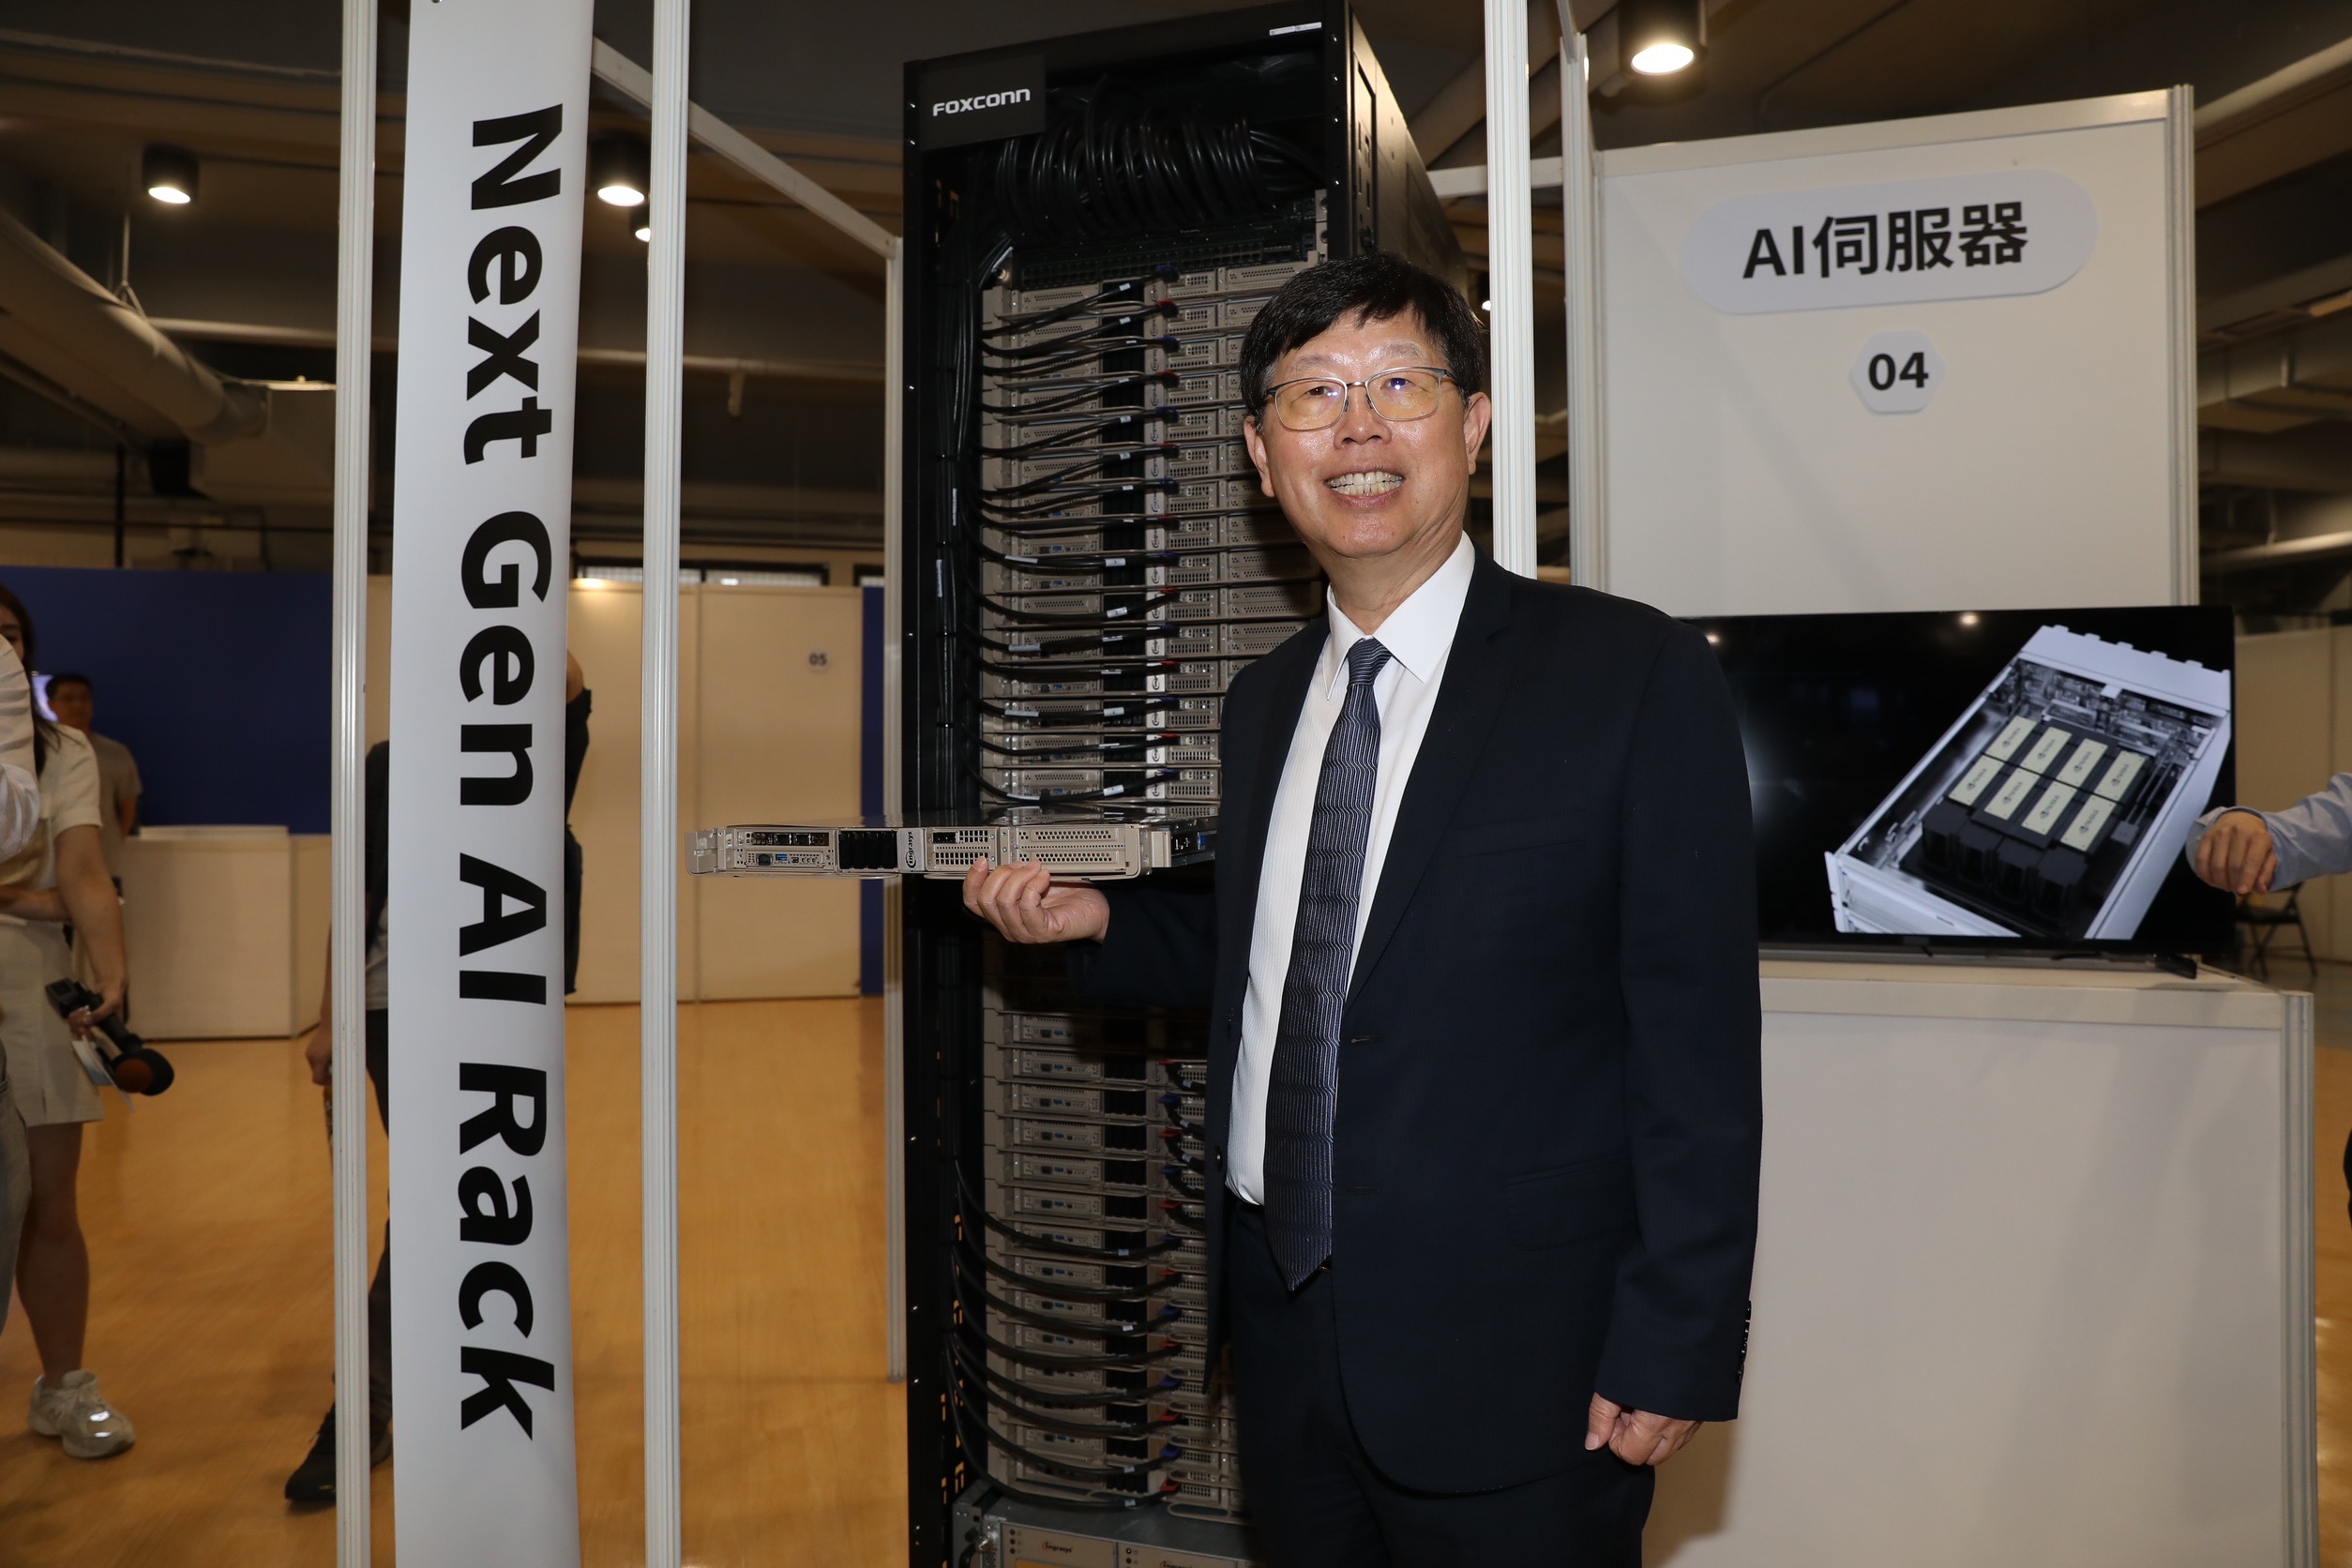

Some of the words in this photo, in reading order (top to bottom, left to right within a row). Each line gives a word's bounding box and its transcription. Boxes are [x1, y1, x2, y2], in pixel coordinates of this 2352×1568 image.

[932, 88, 1031, 116] FOXCONN
[463, 103, 563, 465] Next
[1742, 201, 2028, 279] AI伺服器
[1868, 352, 1929, 391] 04
[460, 511, 552, 806] Gen
[460, 852, 547, 1005] AI
[458, 1063, 555, 1440] Rack
